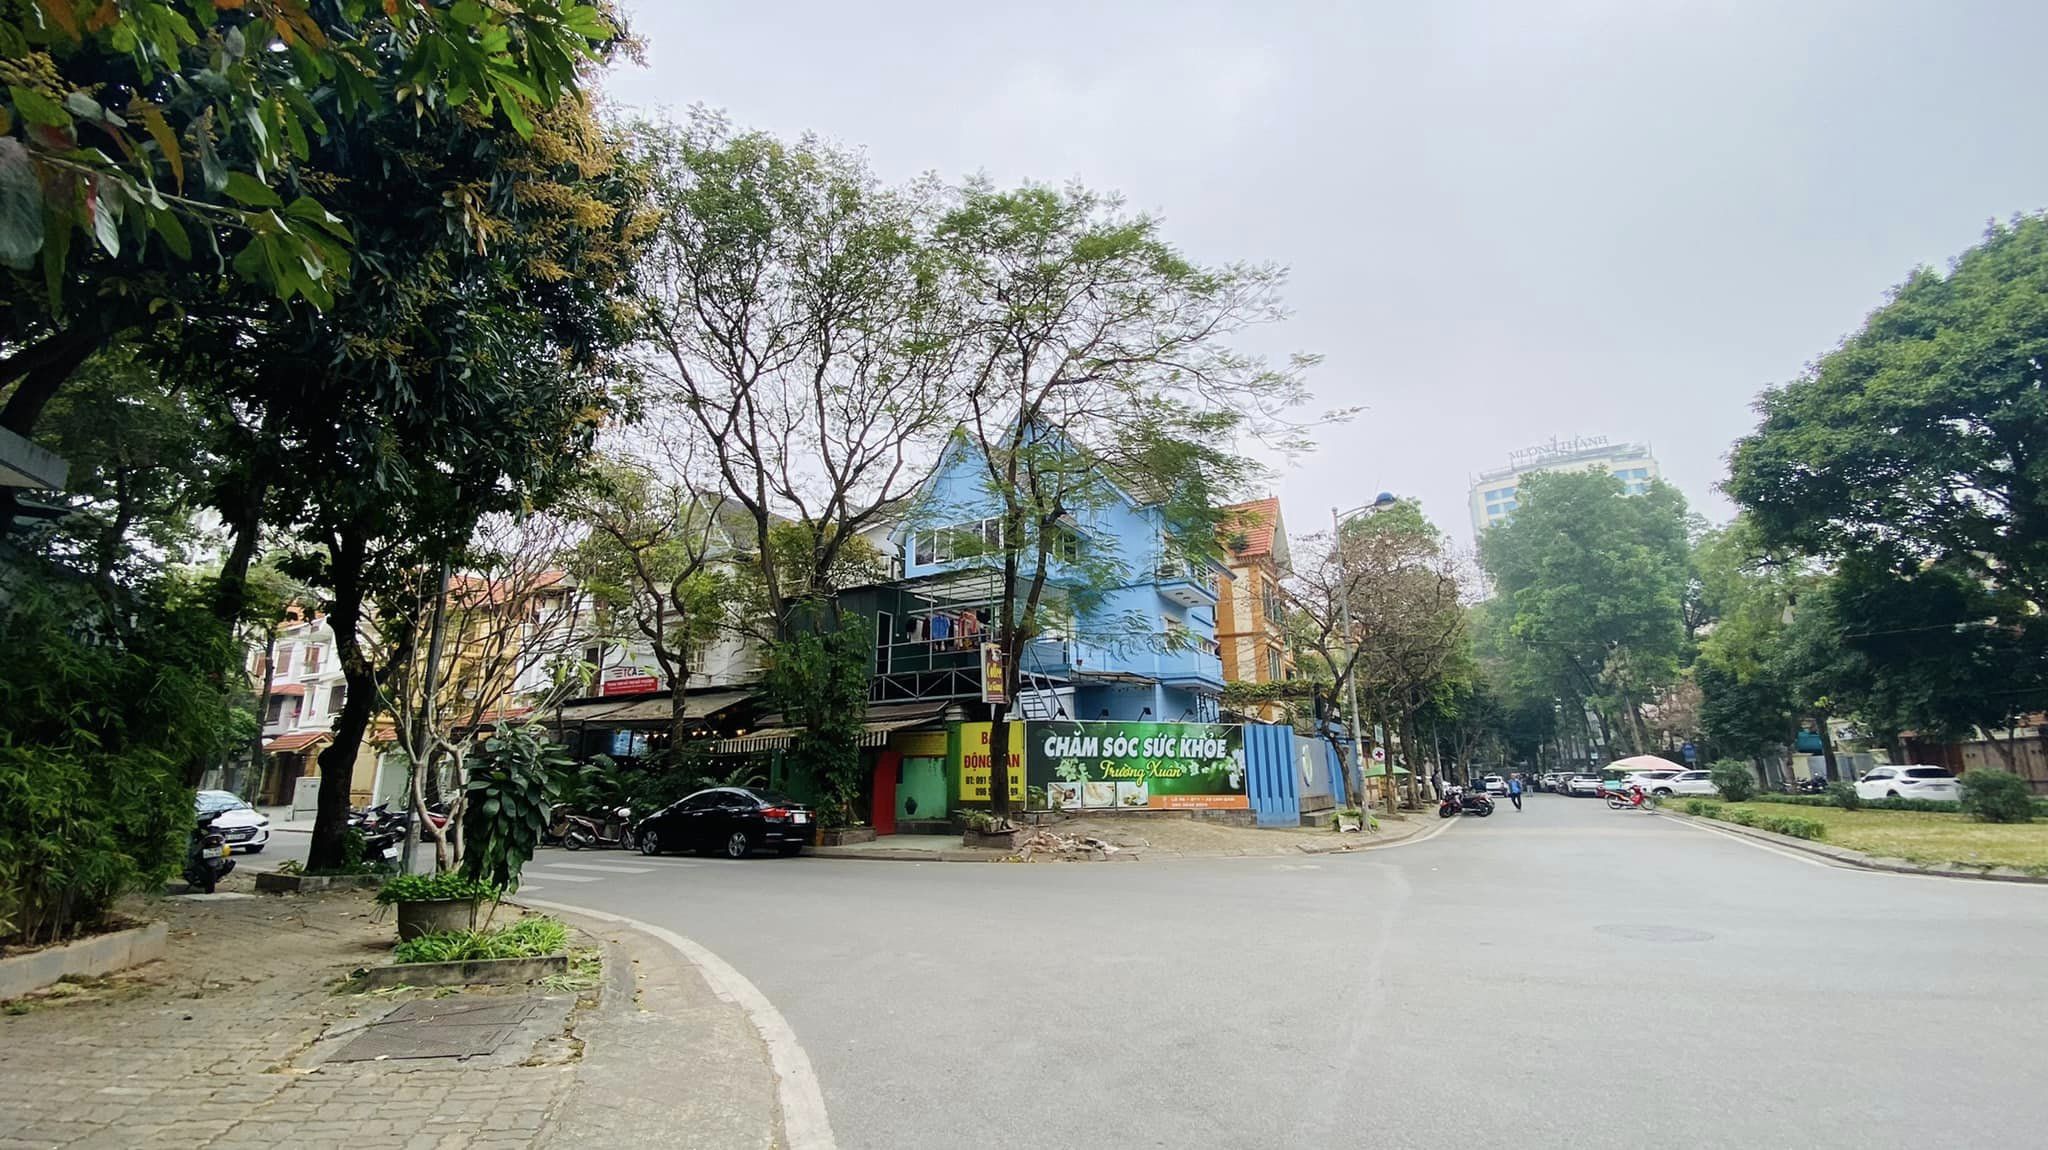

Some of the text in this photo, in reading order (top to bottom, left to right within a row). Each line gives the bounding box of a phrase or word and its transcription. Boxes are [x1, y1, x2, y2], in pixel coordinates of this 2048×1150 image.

[1044, 731, 1228, 761] CHĂM SÓC SỨC KHỎE
[1099, 759, 1183, 787] Trường Xuân
